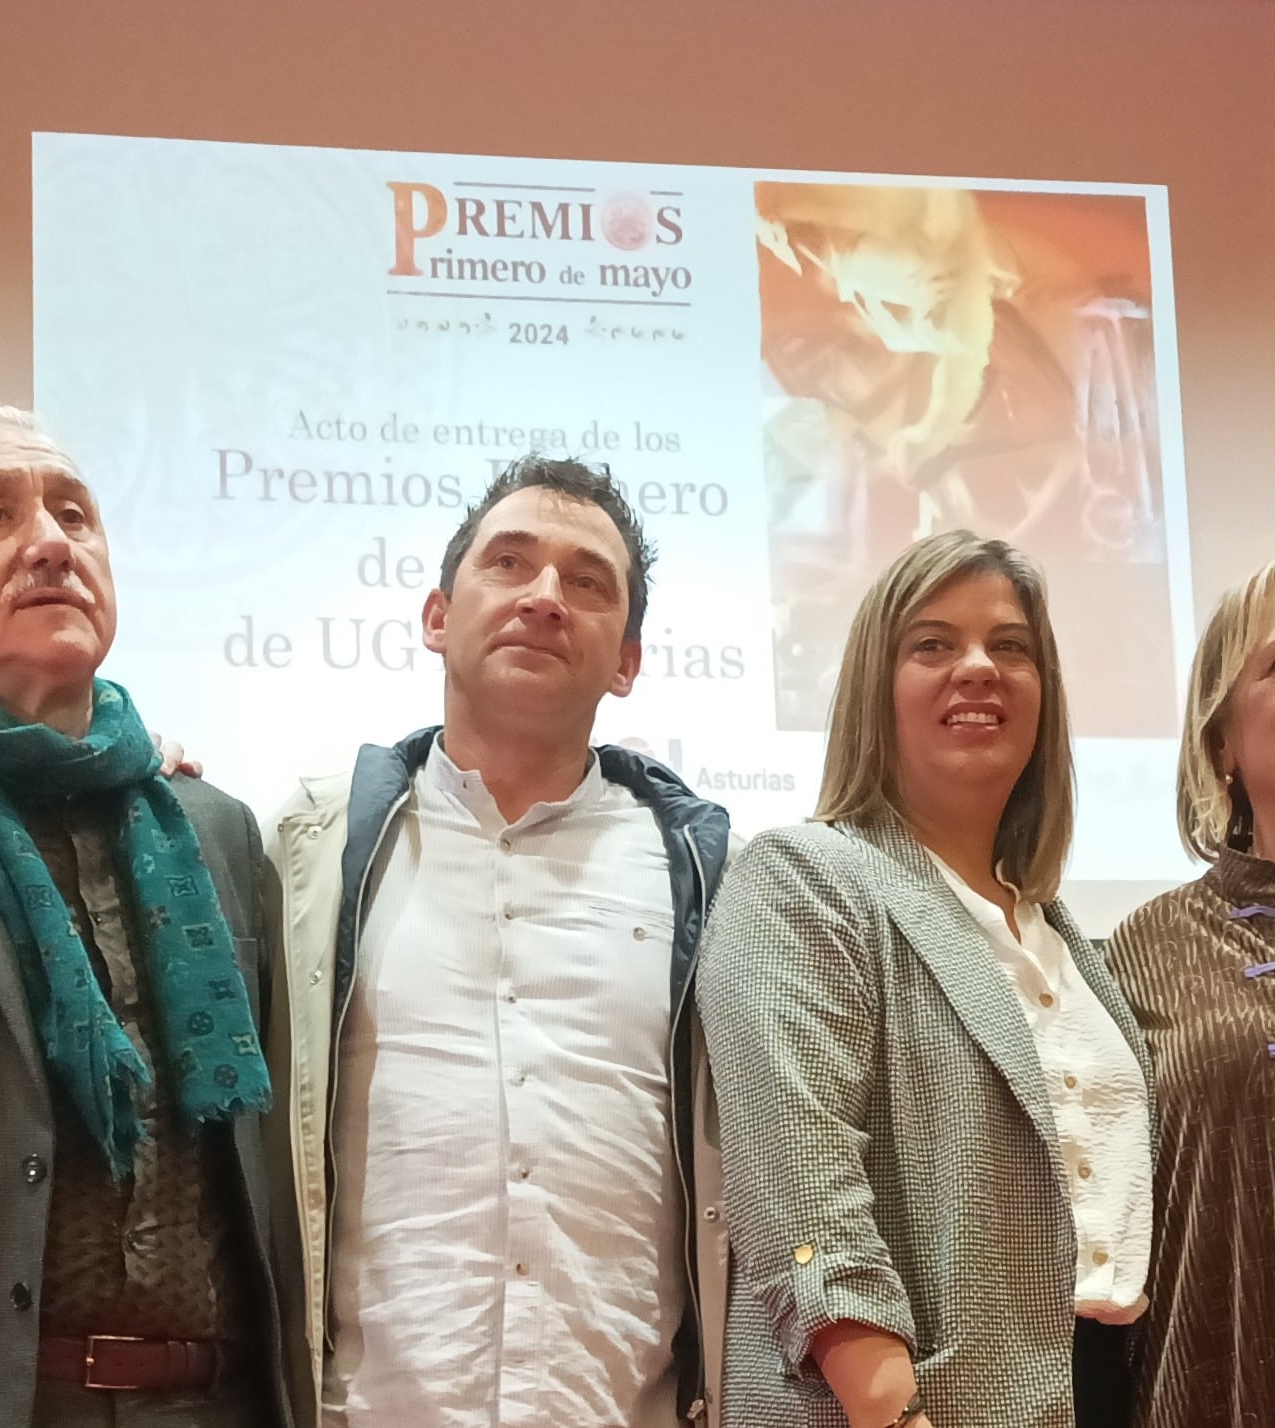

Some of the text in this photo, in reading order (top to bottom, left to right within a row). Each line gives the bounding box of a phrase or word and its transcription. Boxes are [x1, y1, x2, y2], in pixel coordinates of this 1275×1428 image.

[559, 265, 585, 286] de
[599, 262, 692, 297] mayo
[509, 321, 569, 346] 2024
[287, 409, 681, 458] Acto de entrega de los
[211, 448, 463, 510] Premios
[356, 536, 425, 590] de
[222, 614, 294, 669] de
[695, 767, 797, 792] Asturias
